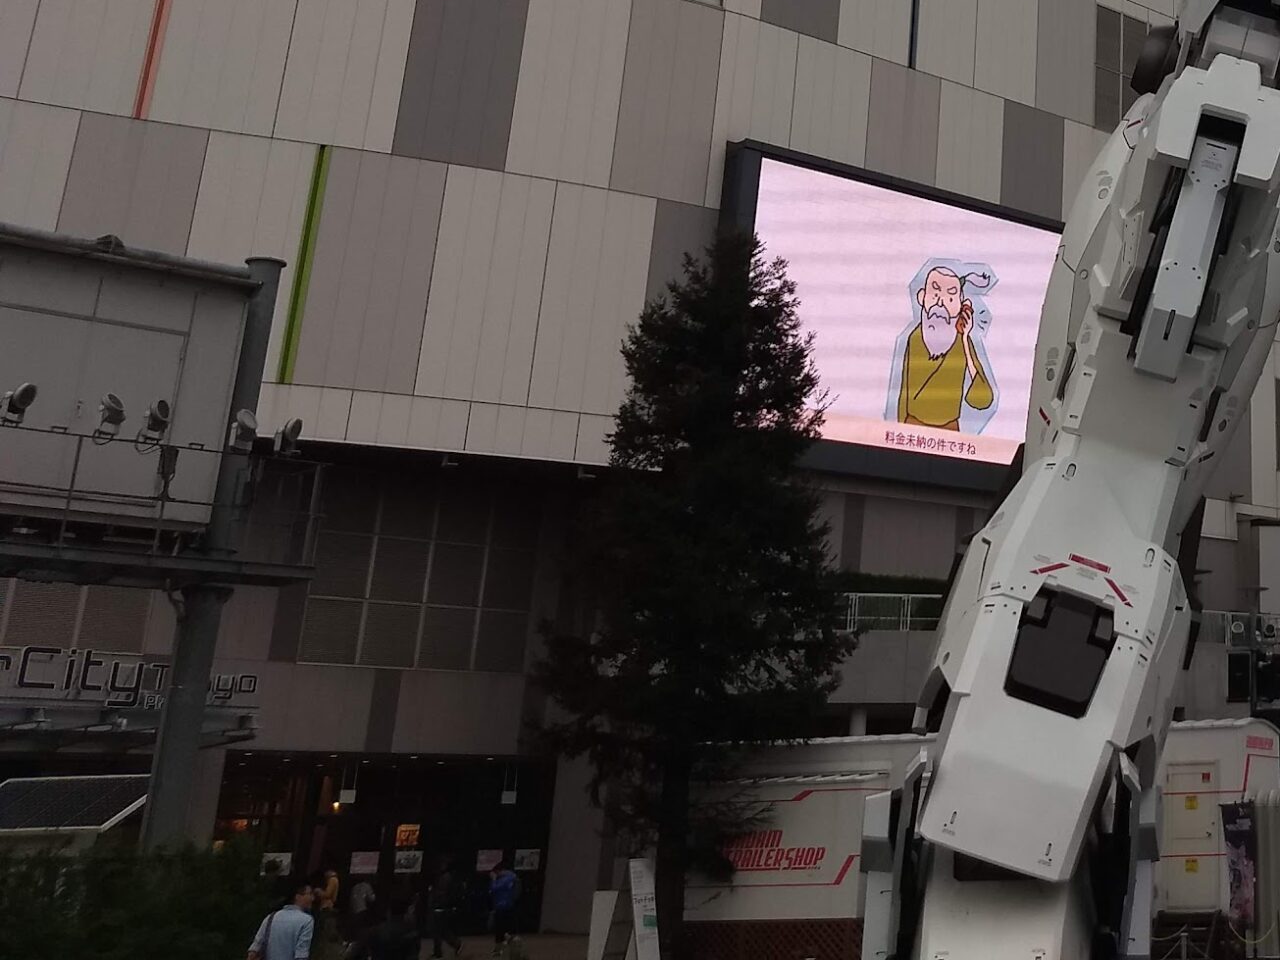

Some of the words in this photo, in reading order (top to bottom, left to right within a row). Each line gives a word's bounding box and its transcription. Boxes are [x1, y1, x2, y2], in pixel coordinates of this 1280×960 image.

[884, 430, 977, 455] 料金未納の件ですね
[152, 662, 258, 701] Tyo
